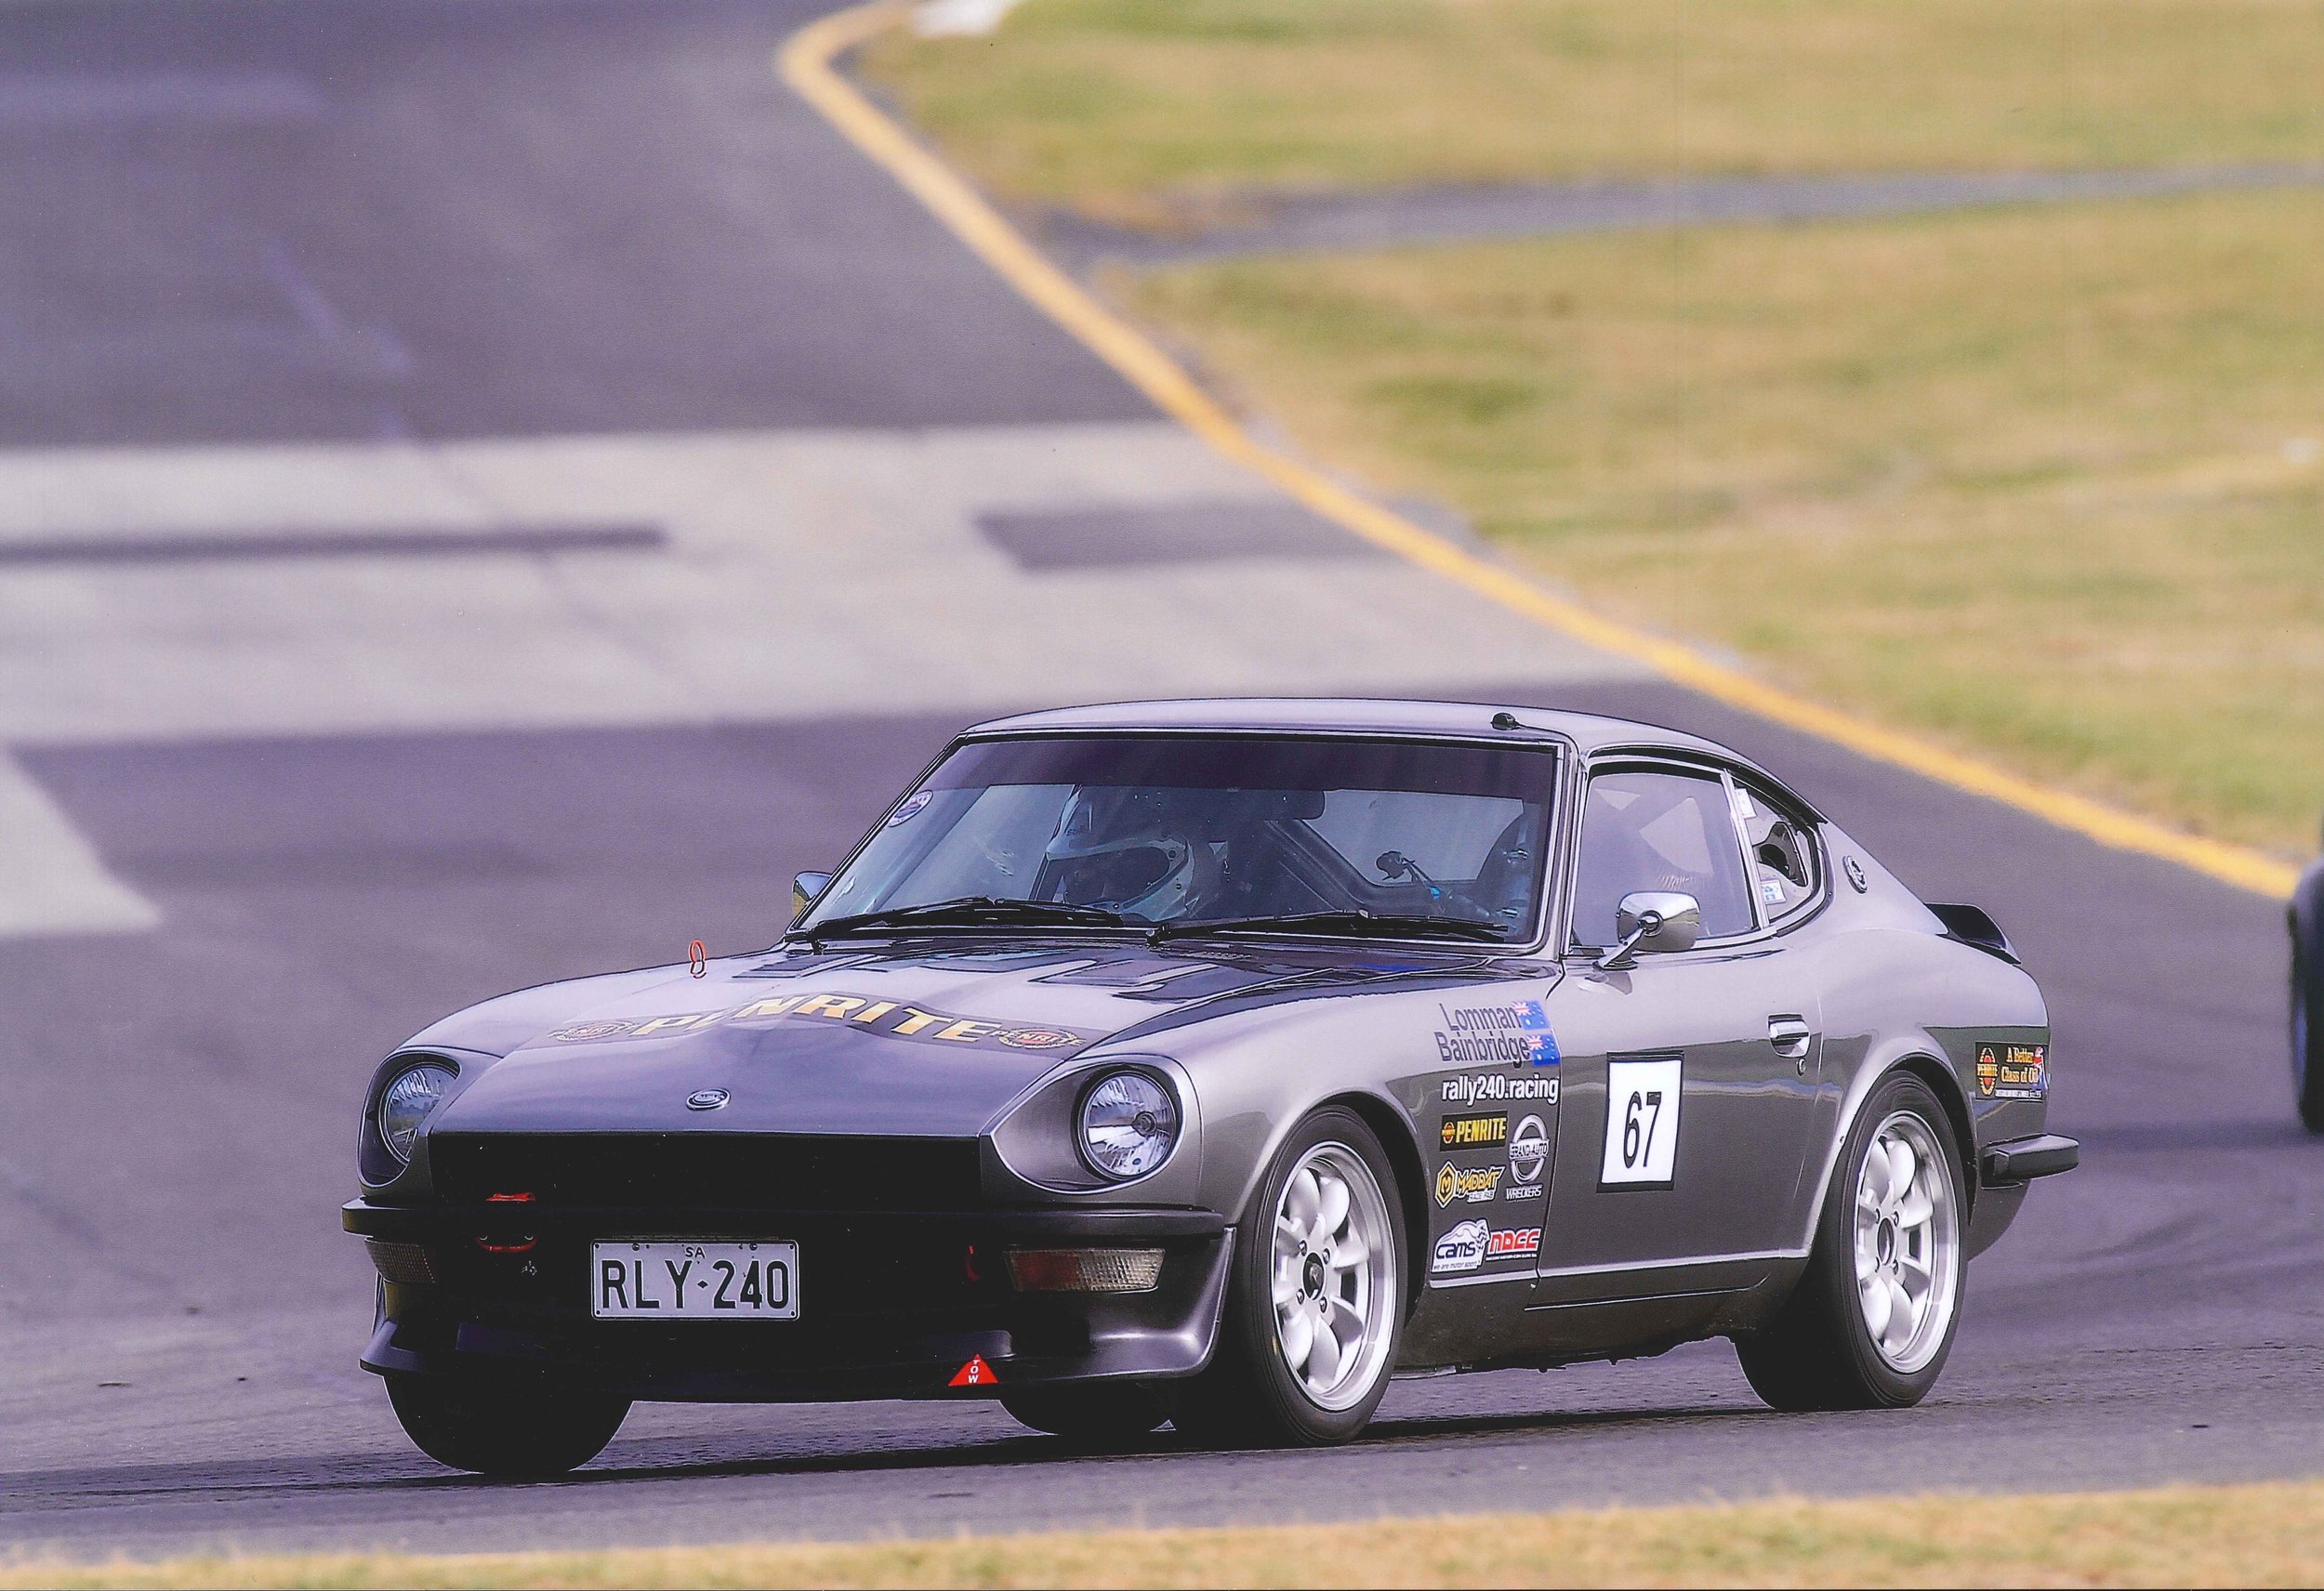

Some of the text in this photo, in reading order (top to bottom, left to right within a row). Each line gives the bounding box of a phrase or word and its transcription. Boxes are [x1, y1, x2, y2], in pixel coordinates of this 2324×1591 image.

[628, 993, 1003, 1043] PENRITE
[1439, 1003, 1522, 1031] Lomman
[1434, 1031, 1531, 1068] Bainbridge
[2000, 1066, 2020, 1083] Class
[1442, 1072, 1560, 1106] rally240.racing
[1456, 1118, 1507, 1143] PENRITE
[1623, 1090, 1662, 1169] 67
[685, 1246, 706, 1258] SA
[969, 1360, 981, 1384] TOW
